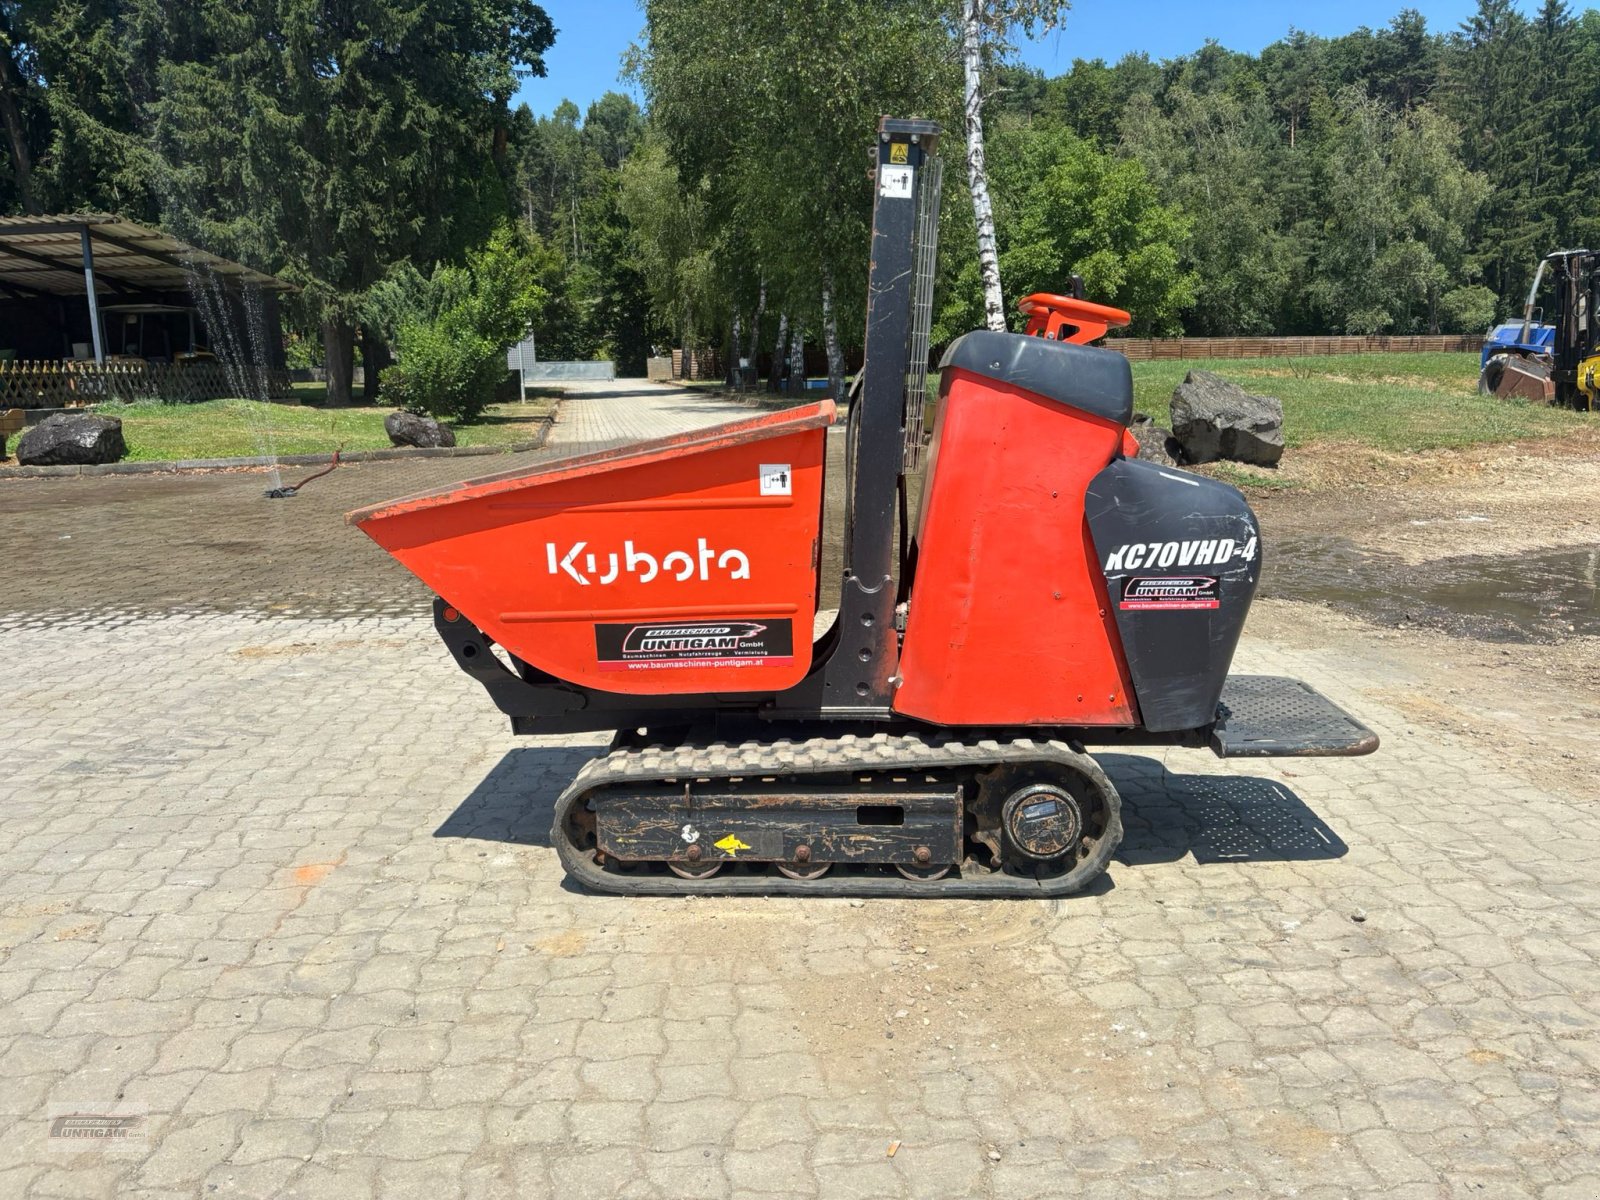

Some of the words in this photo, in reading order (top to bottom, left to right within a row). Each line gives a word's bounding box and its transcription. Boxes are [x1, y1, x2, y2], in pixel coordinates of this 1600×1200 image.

[546, 538, 750, 585] Kubota
[1105, 537, 1257, 571] KC70VHD-4
[628, 659, 764, 669] www.baumaschinen-puntigam.at
